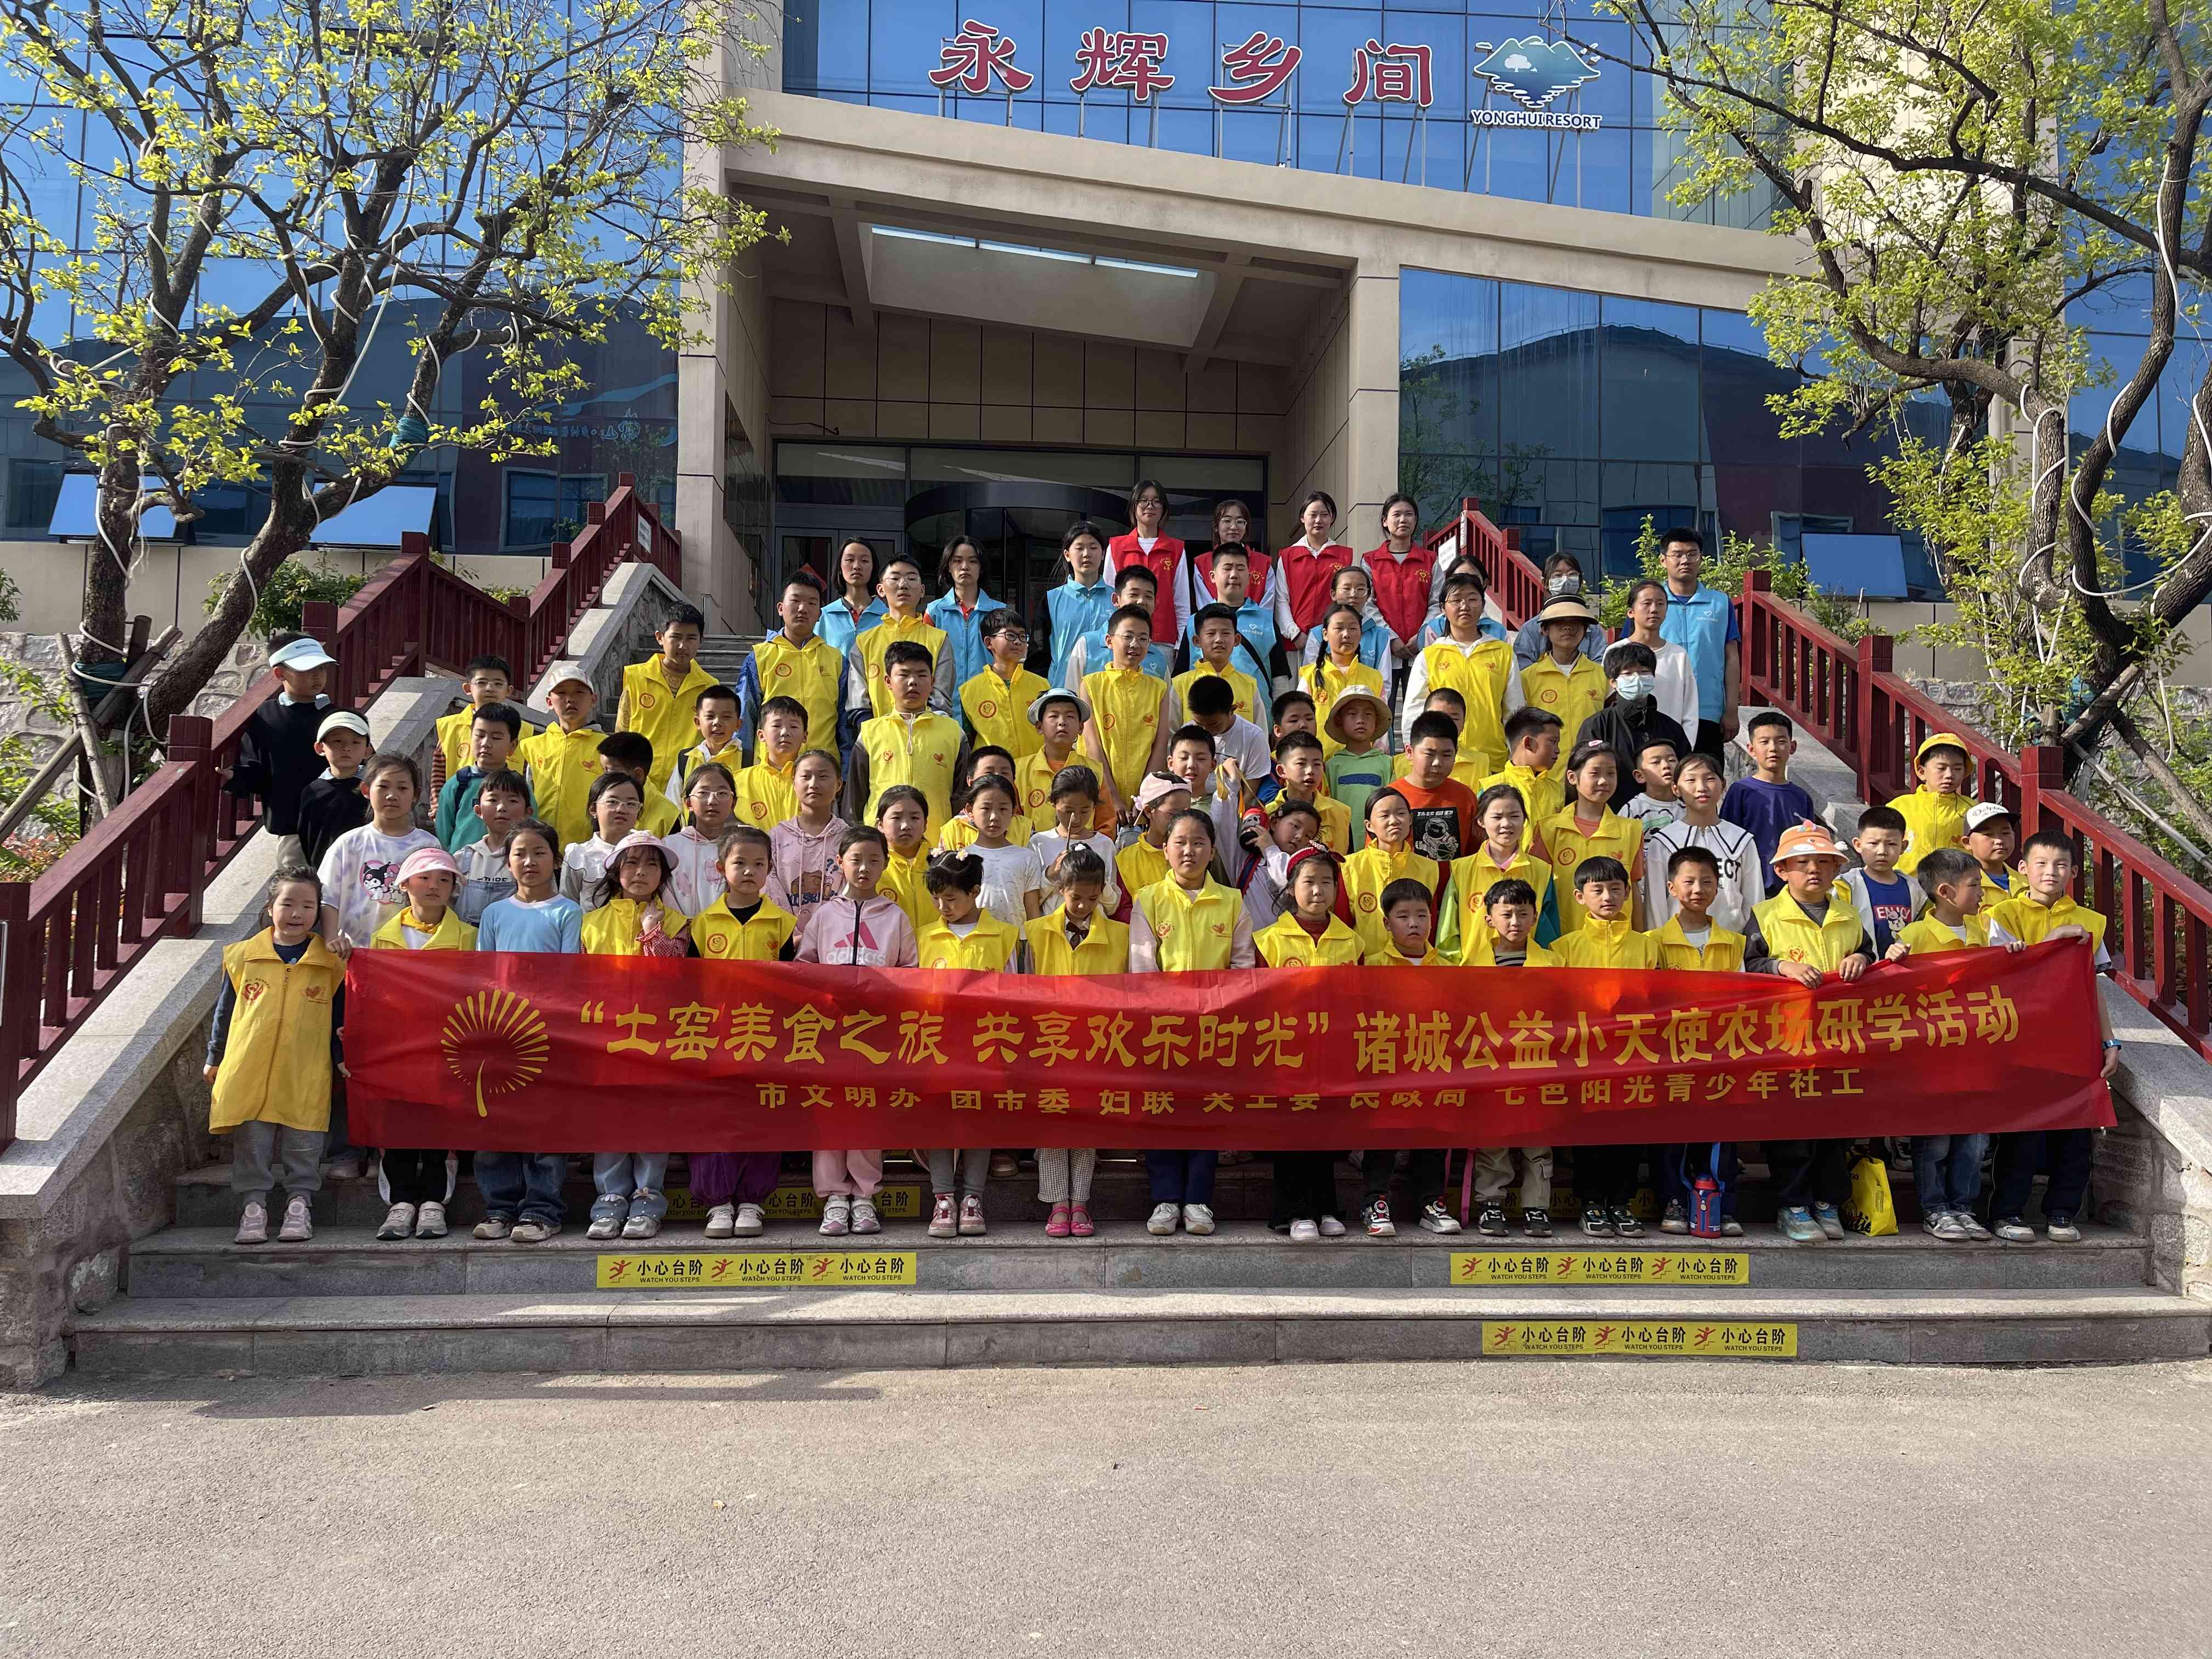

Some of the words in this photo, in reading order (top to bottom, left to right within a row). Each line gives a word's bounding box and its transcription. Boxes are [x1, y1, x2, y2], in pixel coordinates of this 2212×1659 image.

[928, 19, 1433, 107] 永辉乡间
[1353, 985, 2019, 1074] 诸城公益小天使农场研学活动
[755, 1083, 922, 1109] 市文明办
[951, 1088, 1070, 1115] 团市委
[1099, 1089, 1175, 1116] 妇联
[1495, 1068, 1864, 1105] 七色阳光青少年社工
[636, 1259, 703, 1276] 小心台阶
[738, 1257, 805, 1275] 小心台阶
[839, 1257, 905, 1274] 小心台阶
[1487, 1256, 1549, 1273] 小心台阶
[1582, 1256, 1644, 1273] 小心台阶
[1677, 1257, 1738, 1274] 小心台阶
[1521, 1325, 1587, 1344] 小心台阶
[1621, 1326, 1686, 1344] 小心台阶
[1721, 1327, 1786, 1345] 小心台阶
